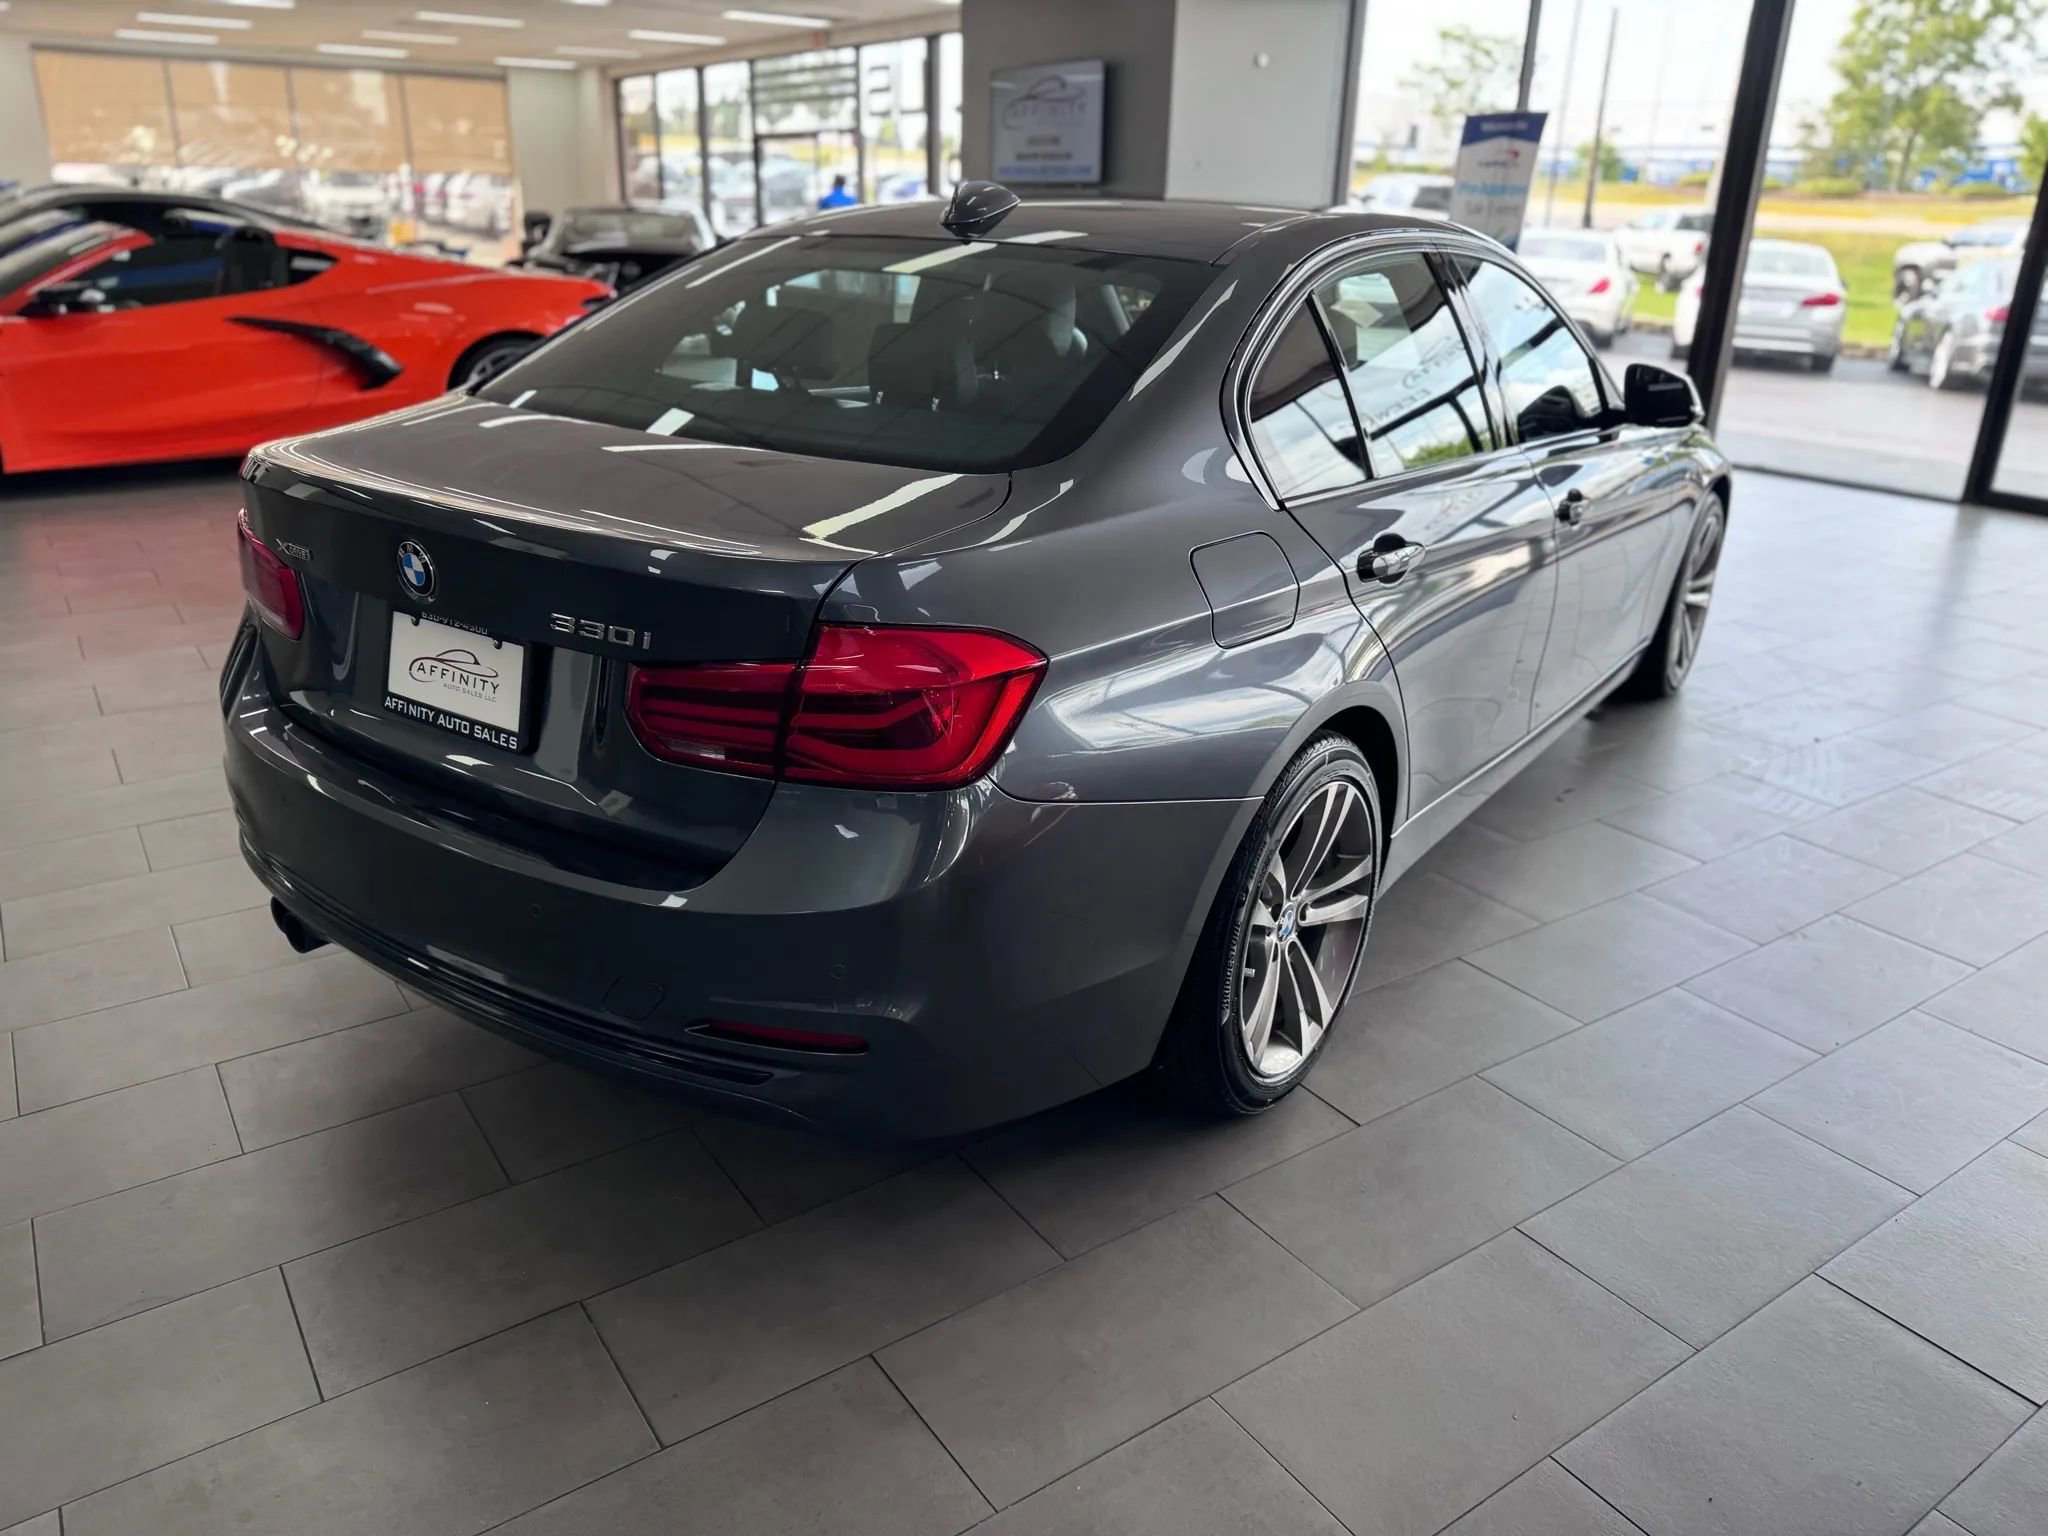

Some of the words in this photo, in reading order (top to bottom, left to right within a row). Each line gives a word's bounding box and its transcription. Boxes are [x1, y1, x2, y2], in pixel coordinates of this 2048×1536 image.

[398, 542, 427, 564] BMW
[549, 611, 652, 650] 330i
[416, 661, 500, 694] AFFINITY
[442, 682, 462, 693] AUTO
[462, 687, 483, 699] SALES
[484, 694, 497, 702] LLC
[384, 695, 435, 723] AFFINITY
[436, 713, 470, 735] AUTO
[473, 724, 518, 750] SALES
